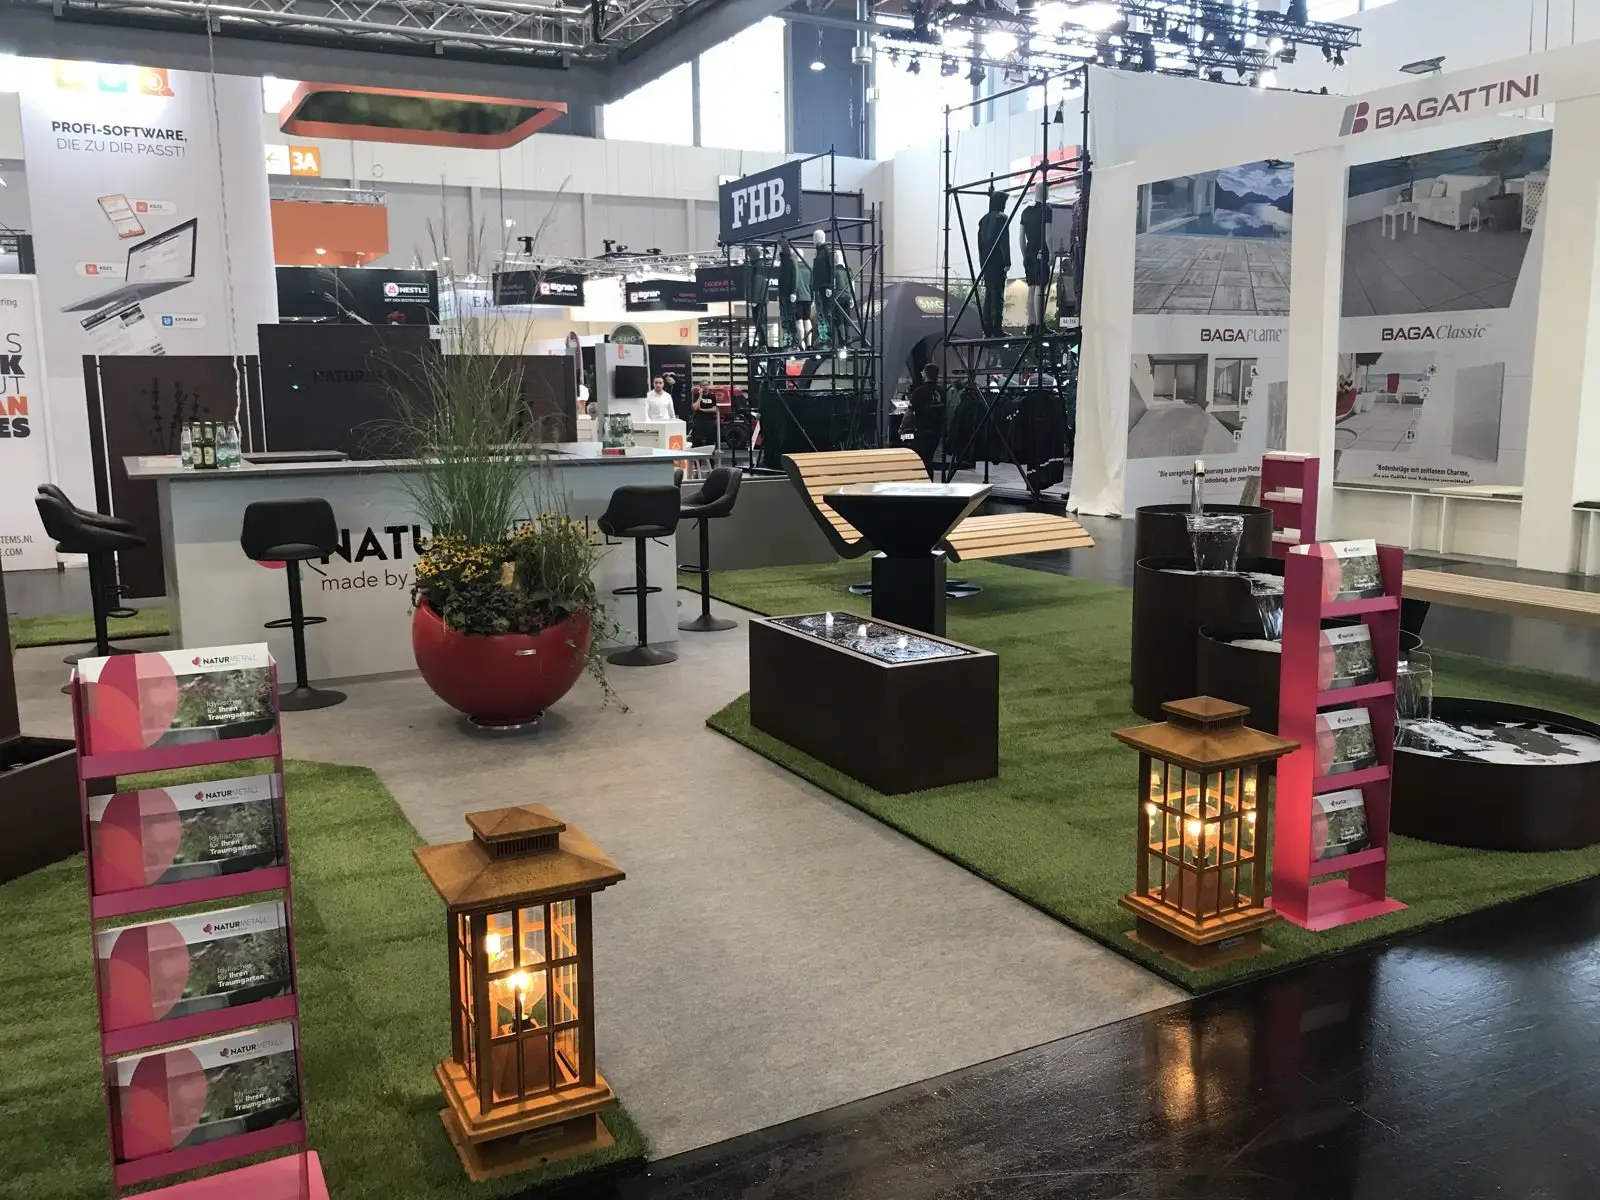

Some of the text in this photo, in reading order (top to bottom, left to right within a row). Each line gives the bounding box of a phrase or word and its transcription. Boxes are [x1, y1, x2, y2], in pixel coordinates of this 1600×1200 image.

[1375, 73, 1539, 130] BAGATTINI
[52, 121, 187, 142] PROFI-SOFTWARE,
[56, 138, 185, 158] DIE ZU DIR PASST!
[292, 151, 318, 171] 3A
[320, 569, 408, 592] made by
[207, 711, 255, 720] Traumgarten
[210, 844, 257, 855] Traumgarten
[221, 839, 240, 847] Ihren
[218, 974, 265, 987] Traumgarten
[229, 971, 248, 979] Ihren
[235, 1096, 280, 1111] Traumgarten
[246, 1093, 264, 1102] Ihren
